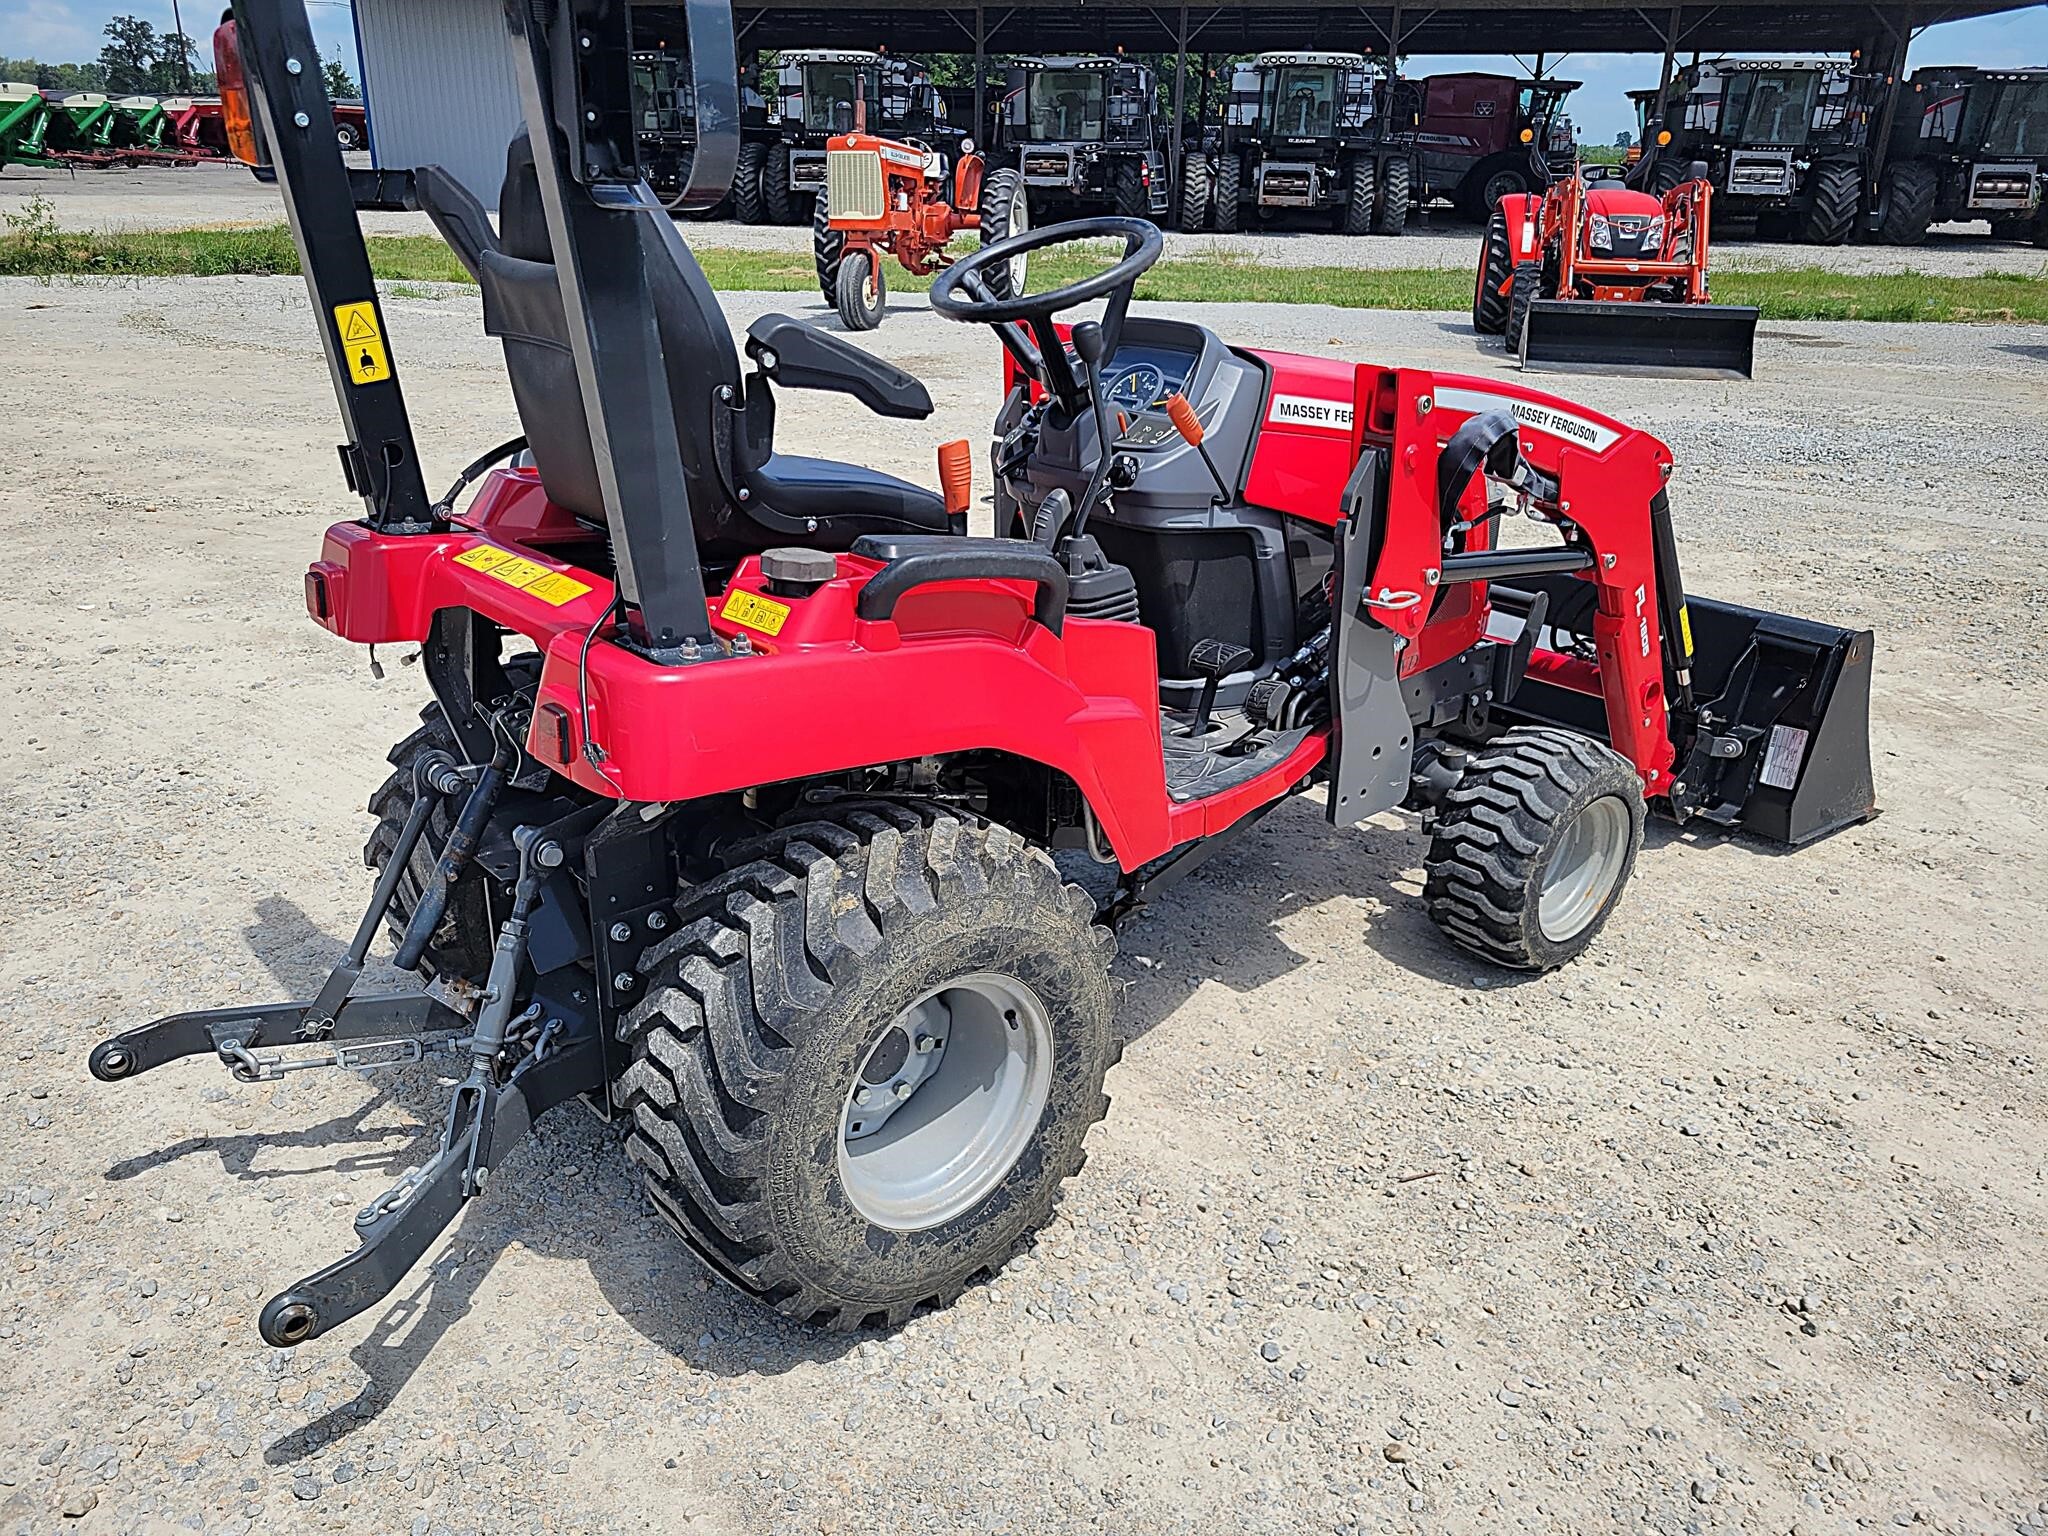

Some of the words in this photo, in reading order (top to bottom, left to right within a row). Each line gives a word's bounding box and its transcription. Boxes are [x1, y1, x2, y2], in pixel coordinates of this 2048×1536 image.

[1280, 402, 1331, 421] MASSEY
[1510, 403, 1550, 425] MASSEY
[1550, 415, 1598, 444] FERGUSON
